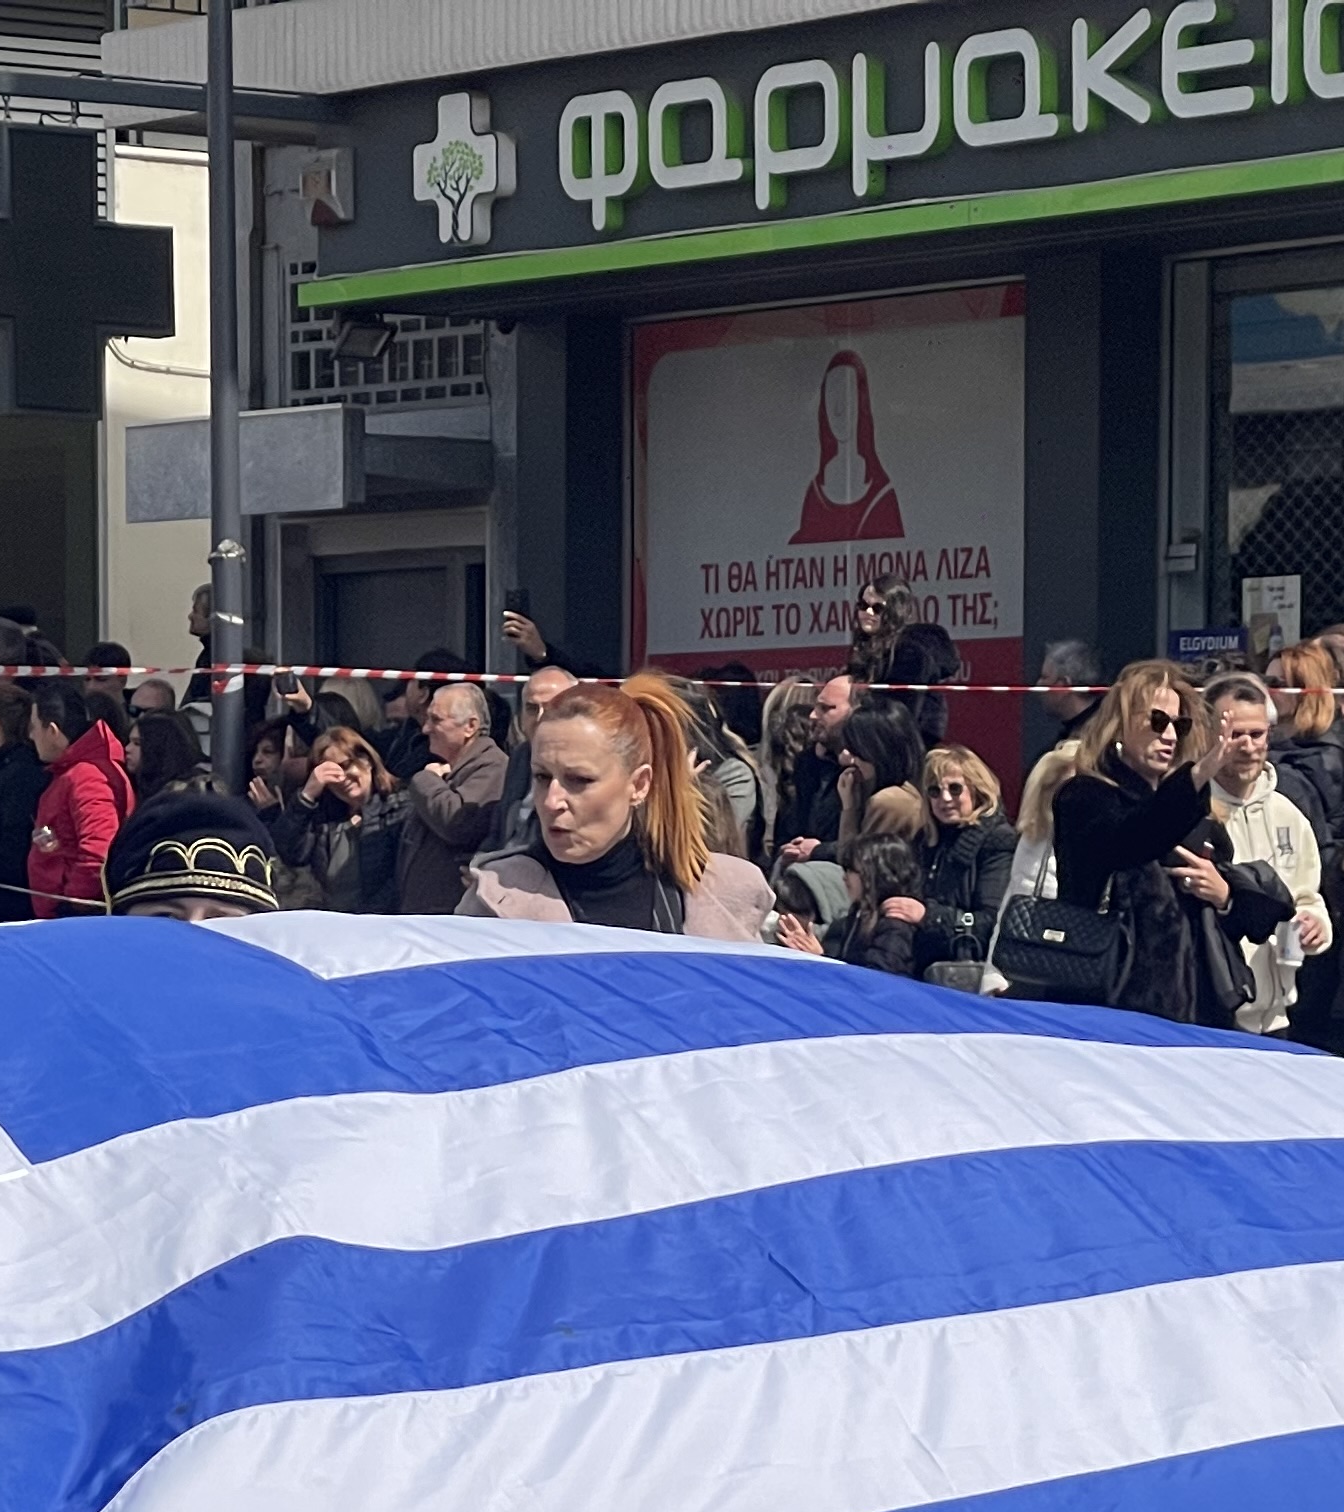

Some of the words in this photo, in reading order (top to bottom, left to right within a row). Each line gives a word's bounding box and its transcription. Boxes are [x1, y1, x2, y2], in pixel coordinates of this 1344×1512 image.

[700, 563, 720, 594] ΤΙ
[727, 560, 758, 592] ΘΑ
[833, 556, 848, 587] Η
[856, 550, 928, 586] ΜΟΝΑ
[936, 546, 991, 581] ΛΙΖΑ
[699, 603, 764, 640] ΧΩΡΙΣ
[771, 601, 801, 635] ΤΟ
[947, 592, 999, 630] ΤΗΣ;
[1179, 636, 1239, 651] ELGYDIUM
